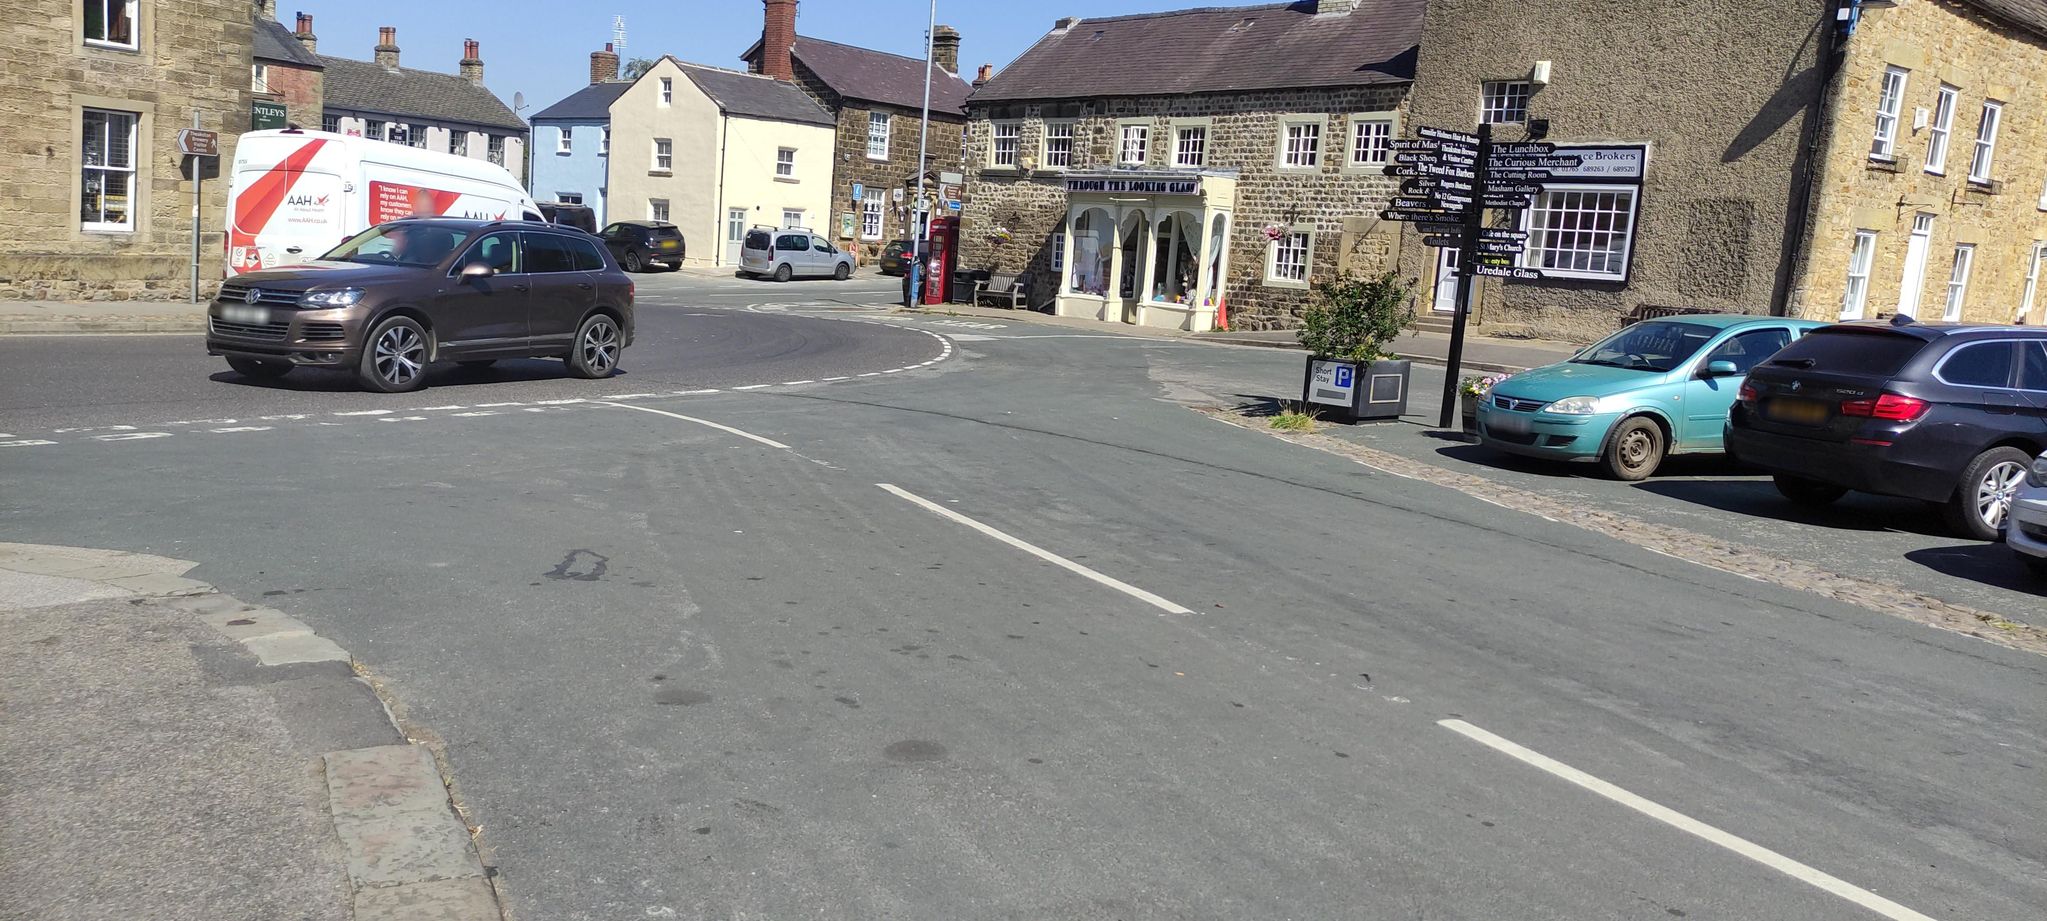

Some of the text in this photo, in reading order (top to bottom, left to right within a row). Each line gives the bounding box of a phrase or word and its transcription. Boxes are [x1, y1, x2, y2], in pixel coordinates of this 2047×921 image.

[1390, 140, 1410, 149] Spirit
[1492, 144, 1549, 153] The Lunchbox
[1399, 153, 1418, 161] Black
[1596, 152, 1636, 160] Brokers
[1488, 158, 1577, 166] The Curious Merchant
[1418, 162, 1474, 178] The Tweed Fox Barbers
[1503, 171, 1526, 180] Cutting
[1068, 181, 1195, 192] THROUGH THE LOOKING GLASS
[1515, 185, 1539, 193] Gallery
[288, 195, 312, 206] AAH
[1395, 199, 1426, 207] Beavers
[1486, 243, 1503, 252] Mary's
[1476, 265, 1538, 279] Uredale Glass
[1316, 367, 1349, 385] Short P
[1316, 375, 1330, 384] Stay
